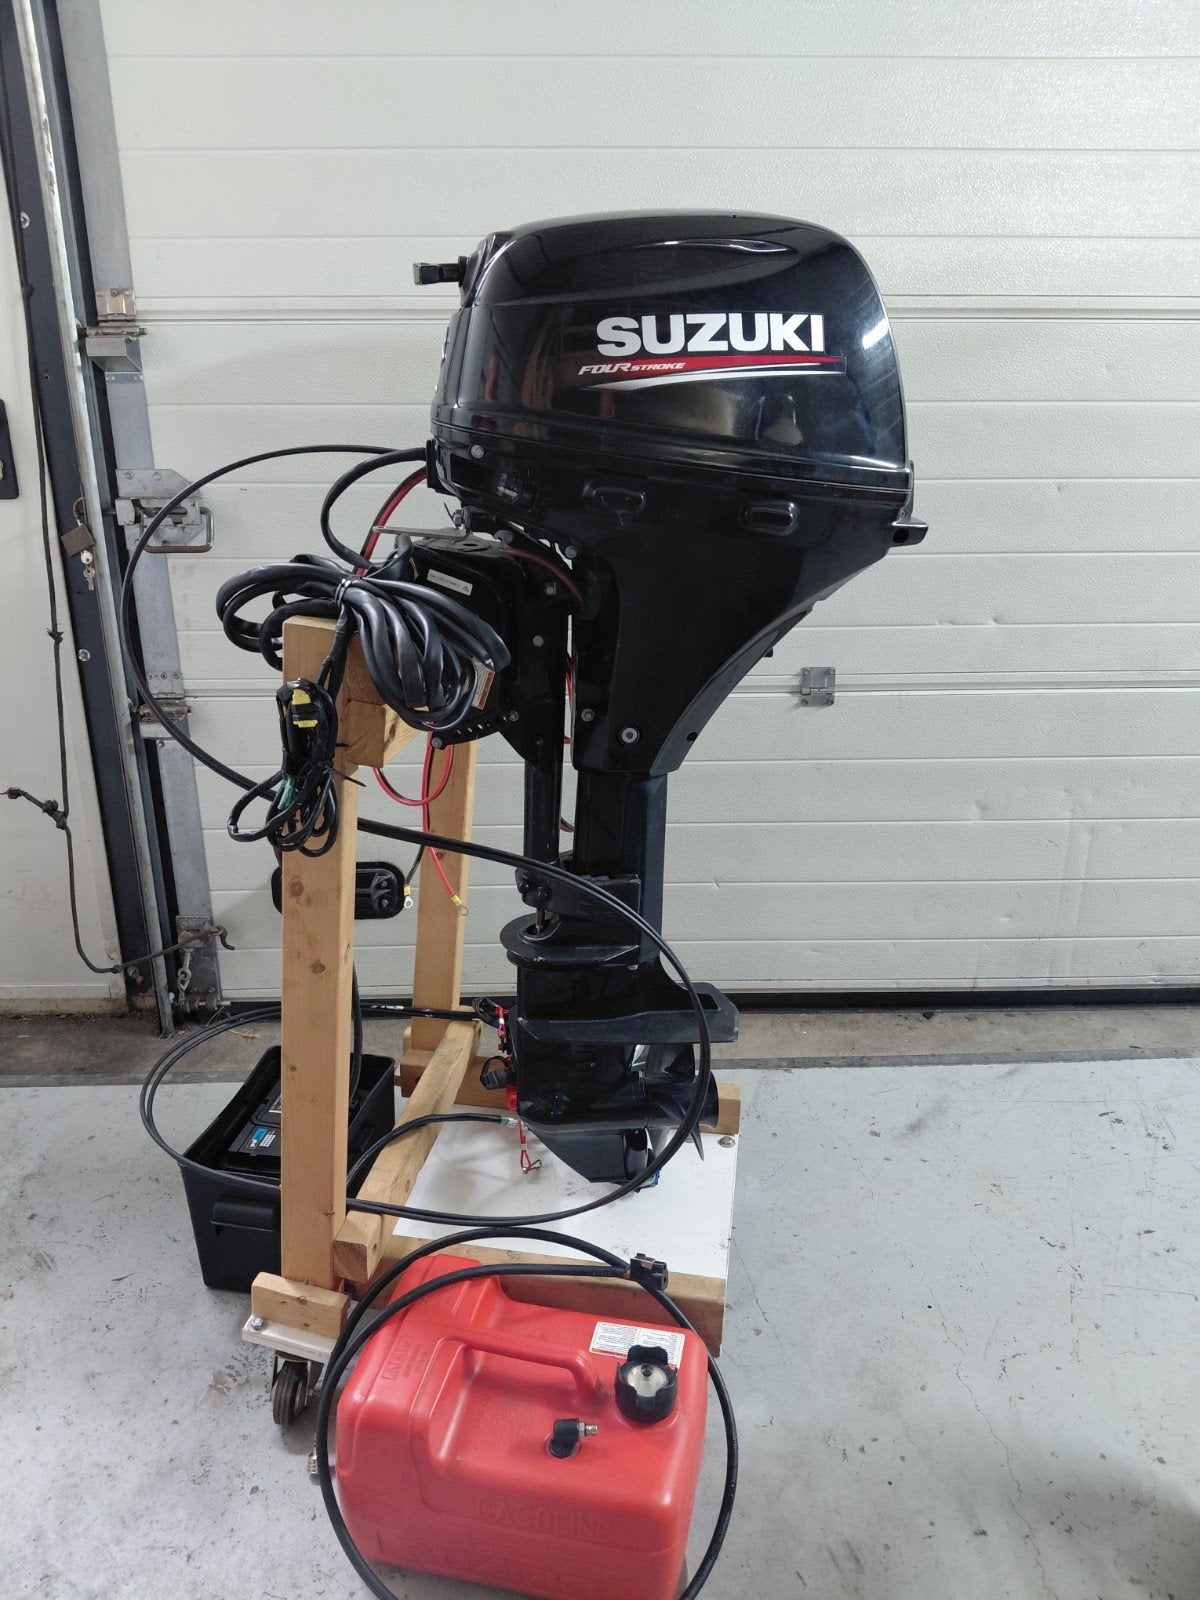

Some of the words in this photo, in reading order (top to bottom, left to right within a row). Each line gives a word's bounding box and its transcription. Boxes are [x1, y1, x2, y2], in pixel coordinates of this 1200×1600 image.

[597, 313, 824, 357] SUZUKI
[578, 362, 632, 376] FOUR
[630, 362, 686, 372] STROKE
